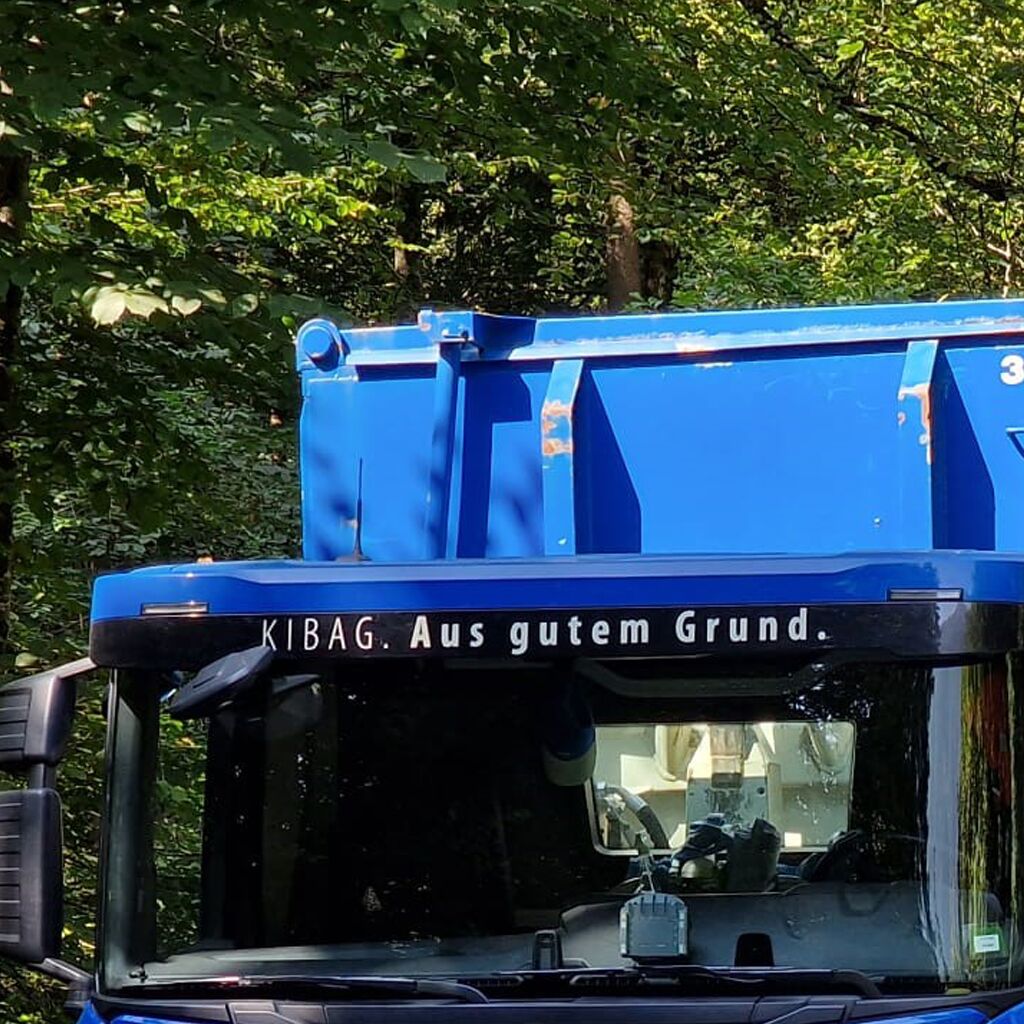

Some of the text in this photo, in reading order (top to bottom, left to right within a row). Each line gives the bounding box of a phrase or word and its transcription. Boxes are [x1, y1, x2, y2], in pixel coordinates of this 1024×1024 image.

[262, 607, 827, 655] KIBAG. Aus gutem Grund.
